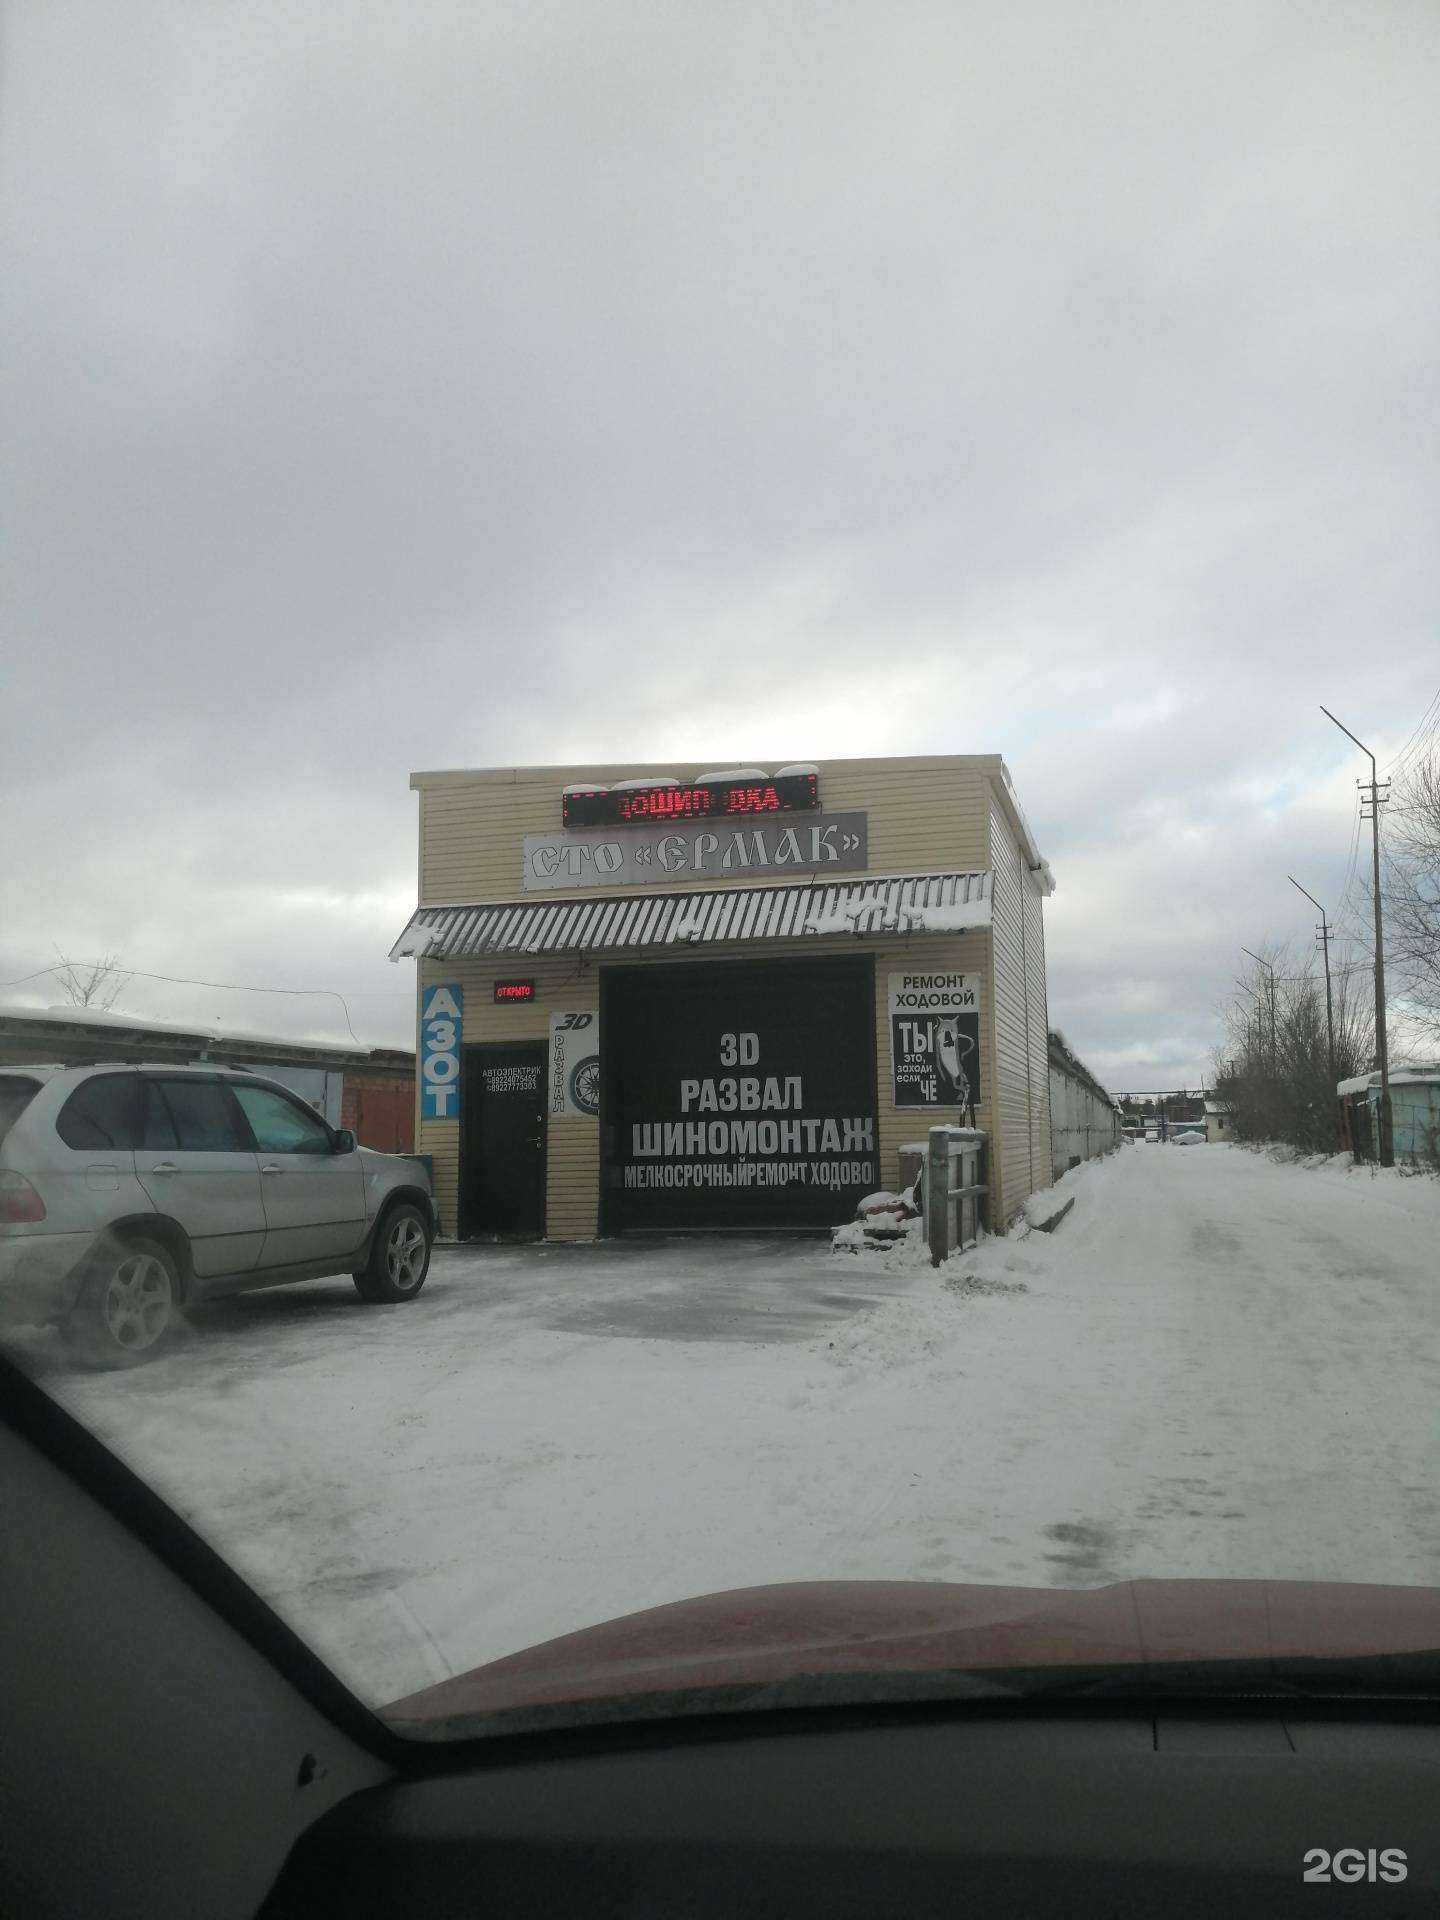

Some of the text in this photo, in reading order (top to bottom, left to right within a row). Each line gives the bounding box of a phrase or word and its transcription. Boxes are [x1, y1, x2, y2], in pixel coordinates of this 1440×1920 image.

[531, 841, 624, 878] СТО
[497, 985, 531, 998] ОТКРЫТО
[903, 975, 966, 988] РЕМОНТ
[896, 990, 975, 1009] ХОДОВОЙ
[555, 1013, 593, 1031] 3D
[423, 988, 462, 1117] АЗОТ
[720, 1032, 760, 1067] 3D
[898, 1021, 934, 1054] ТЫ
[482, 1066, 541, 1077] АВТОЭЛЕКТРИК
[553, 1035, 565, 1112] РАЗВАЛ
[897, 1065, 933, 1074] заходи
[680, 1076, 802, 1112] РАЗВАЛ
[920, 1075, 937, 1101] ЧЁ
[632, 1117, 874, 1157] ШИНОМОНТАЖ
[810, 1161, 875, 1191] ХОДОВО
